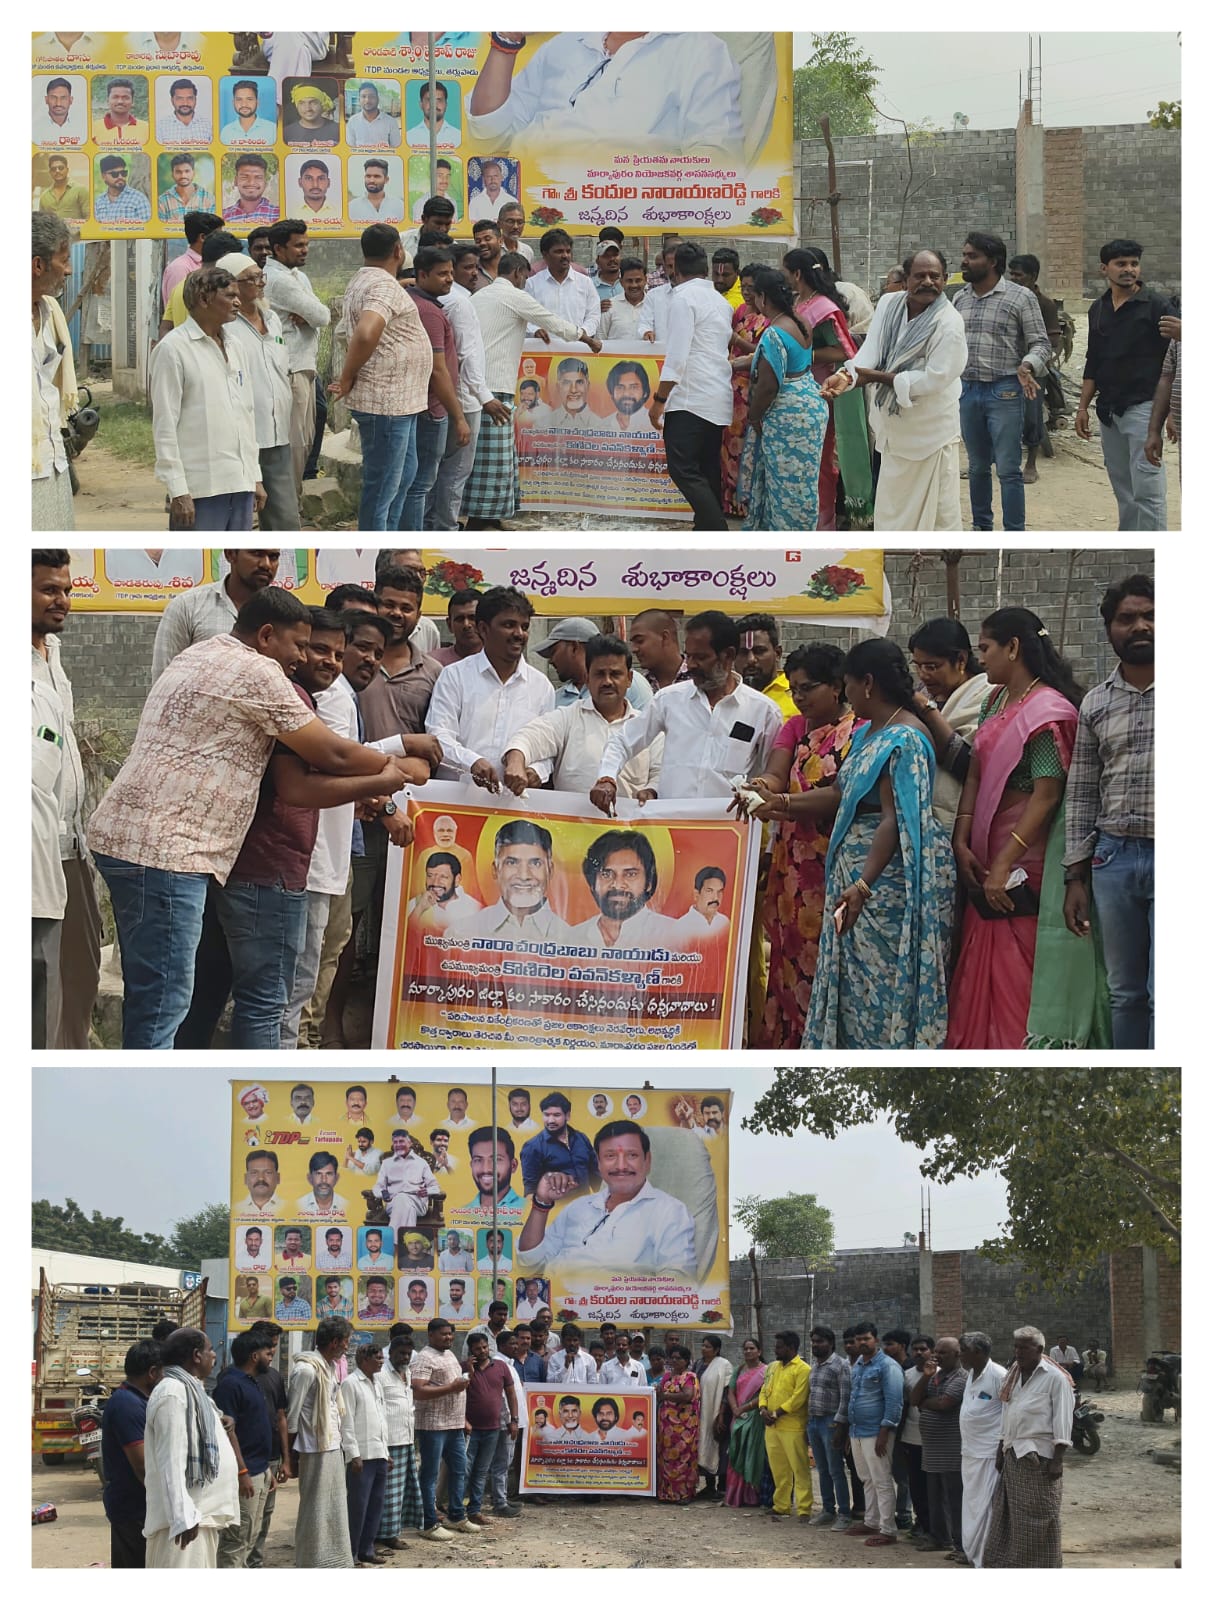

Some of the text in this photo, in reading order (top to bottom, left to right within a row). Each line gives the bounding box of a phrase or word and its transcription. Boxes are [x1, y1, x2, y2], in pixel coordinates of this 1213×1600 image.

[581, 183, 637, 199] కందుల
[641, 182, 747, 206] నారాయణరెడ్డి
[578, 206, 731, 228] జన్మదిన శుభాకాంక్షలు
[509, 560, 777, 601] జన్మదిన శుభాకాంక్షలు
[424, 936, 470, 949] ముఖ్యమంత్రి
[471, 937, 514, 952] నారా
[514, 940, 597, 959] చంద్రబాబు
[601, 948, 670, 963] నాయుడు
[441, 960, 501, 977] ఉపముఖ్యమంత్రి
[502, 961, 565, 980] కొణిదెల
[408, 981, 474, 1002] మార్కాపురం
[478, 988, 504, 1007] జిల్లా
[528, 989, 571, 1007] సాకారం
[575, 990, 644, 1013] చేసినందుకు
[647, 998, 709, 1017] ధన్యవాదాలు
[590, 1294, 627, 1305] కందుల
